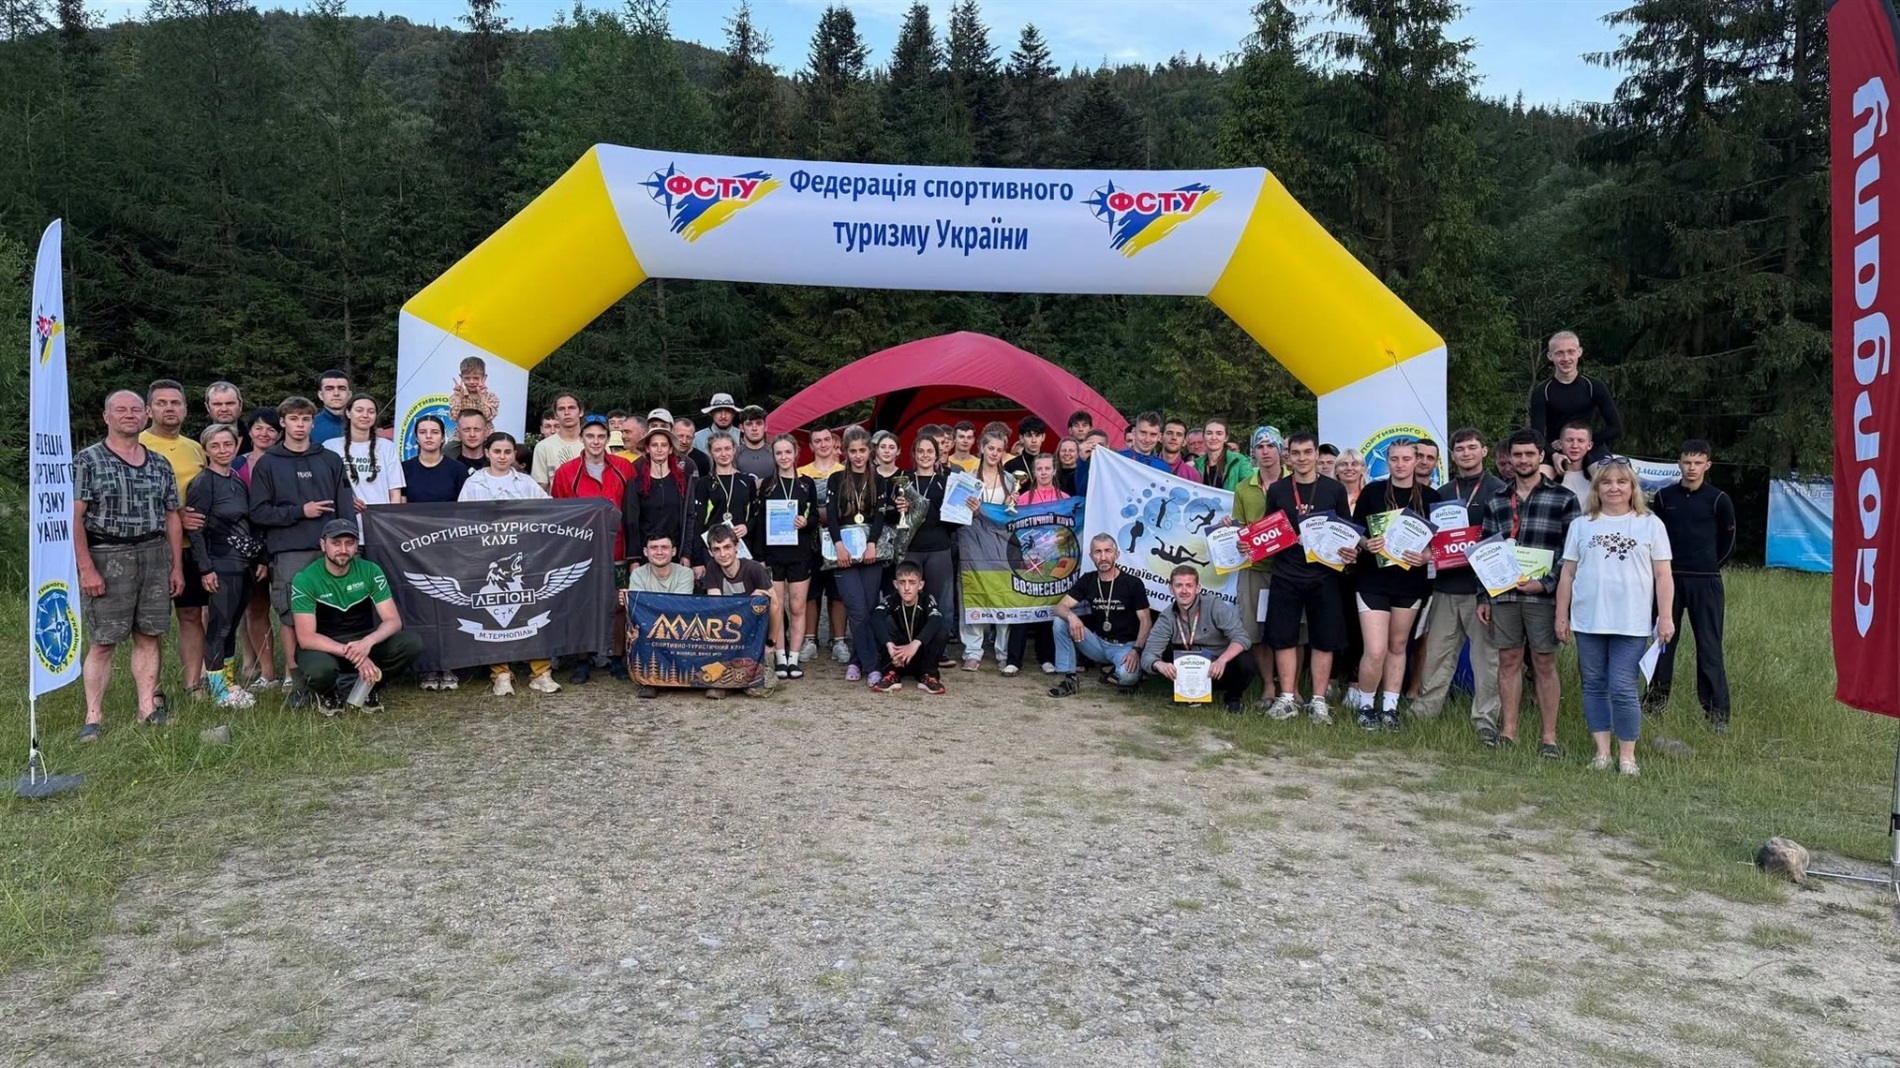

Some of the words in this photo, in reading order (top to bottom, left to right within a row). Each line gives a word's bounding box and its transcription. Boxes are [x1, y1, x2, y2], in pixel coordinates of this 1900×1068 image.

[665, 173, 761, 201] ФСТУ
[789, 169, 917, 202] Федерація
[923, 175, 1074, 204] спортивного
[1107, 190, 1203, 216] ФСТУ
[833, 221, 930, 256] туризму
[937, 215, 1030, 252] України
[403, 396, 451, 427] СПОРТИВНО
[1360, 426, 1421, 454] ПОРТИВНОГО
[400, 521, 595, 553] СПОРТИВНО-ТУРИСТСЬКИЙ
[481, 533, 519, 547] КЛУБ
[1012, 572, 1079, 596] ВОЗНЕСЕНСЬК
[1114, 562, 1172, 587] колаївськ
[475, 591, 532, 607] ЛЕГІОН
[646, 613, 743, 643] MARS
